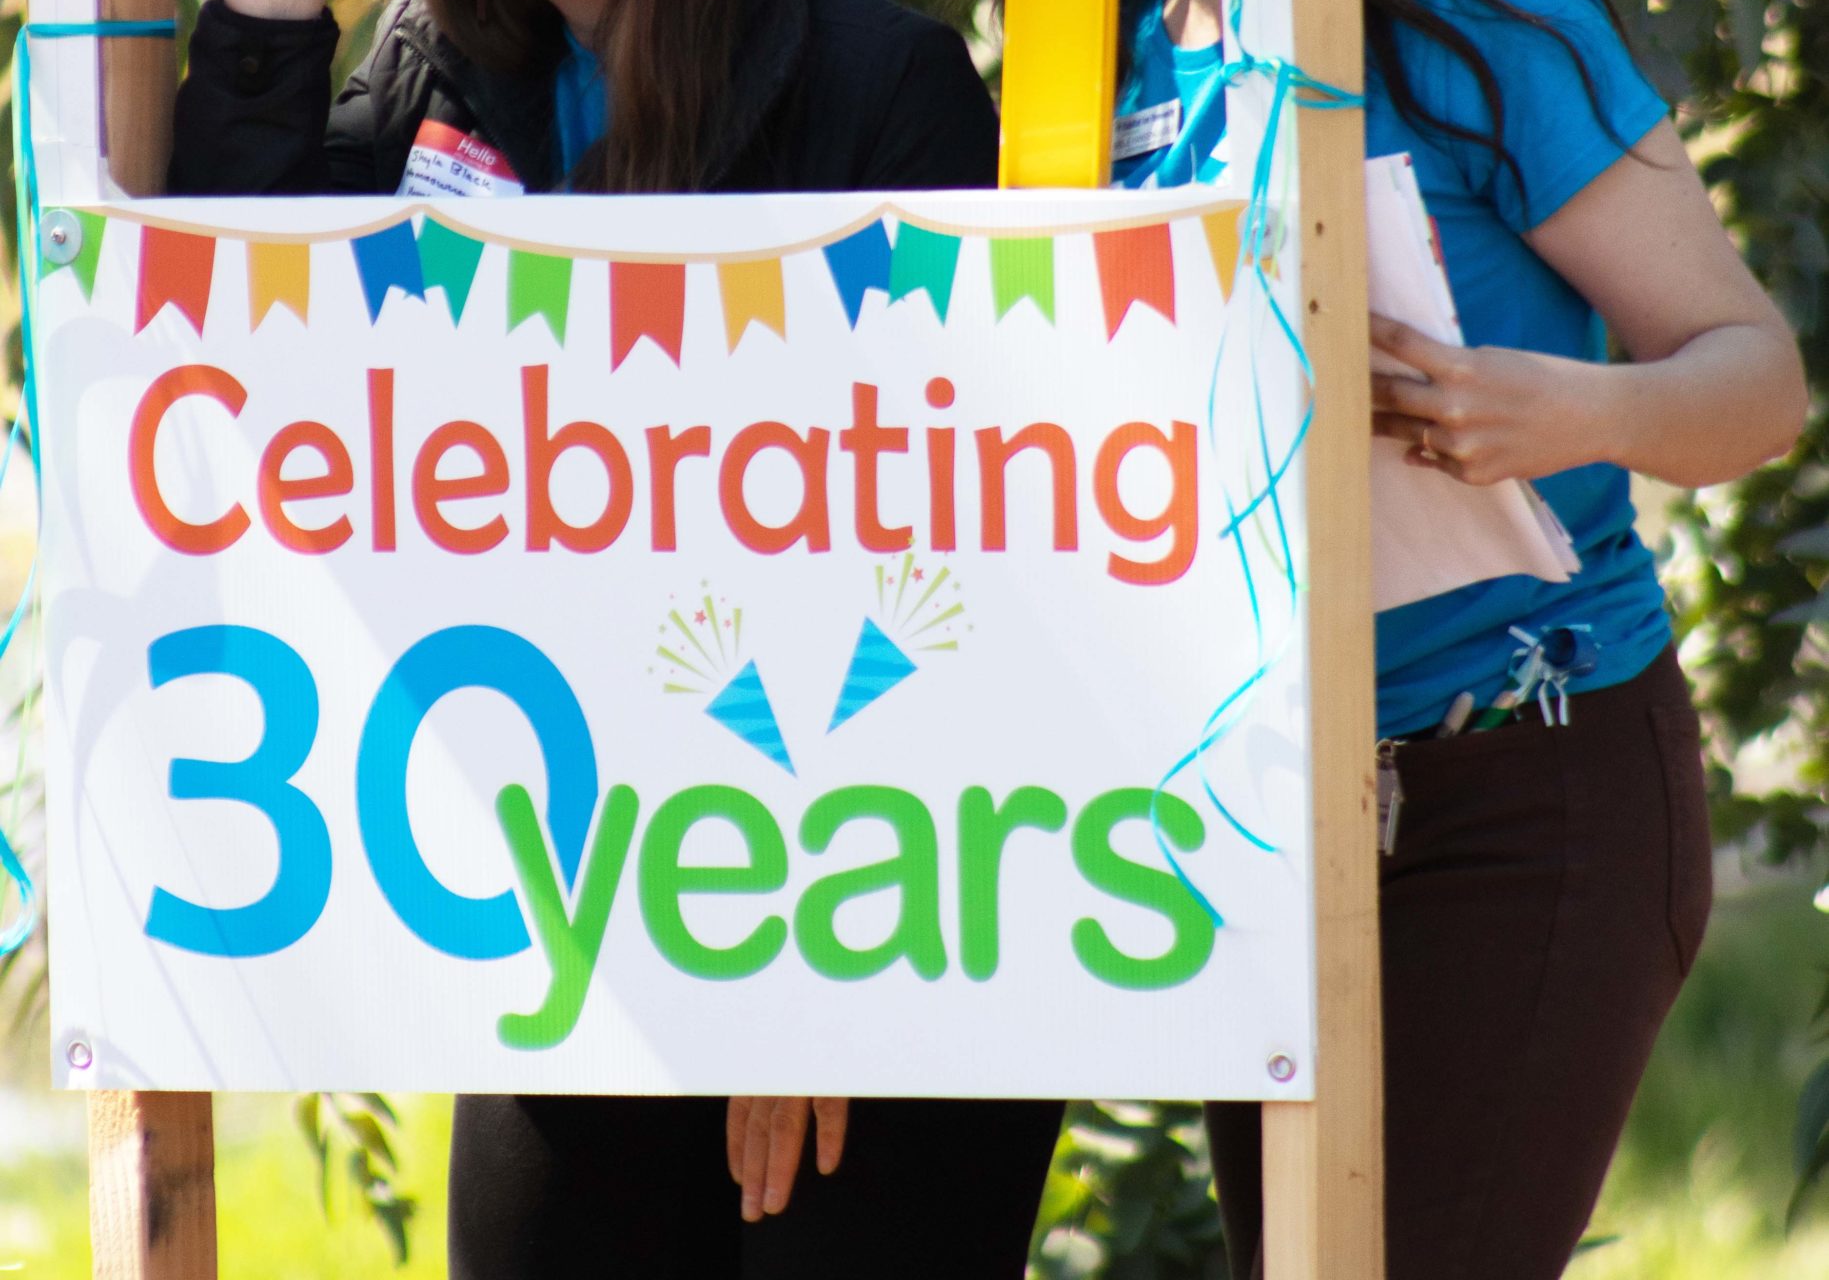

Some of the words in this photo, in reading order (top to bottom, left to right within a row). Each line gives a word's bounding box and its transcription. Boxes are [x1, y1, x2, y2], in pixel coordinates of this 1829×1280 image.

[457, 138, 497, 166] Hello
[128, 363, 1199, 586] Celebrating
[143, 624, 598, 961] 30
[495, 783, 1216, 1052] years
